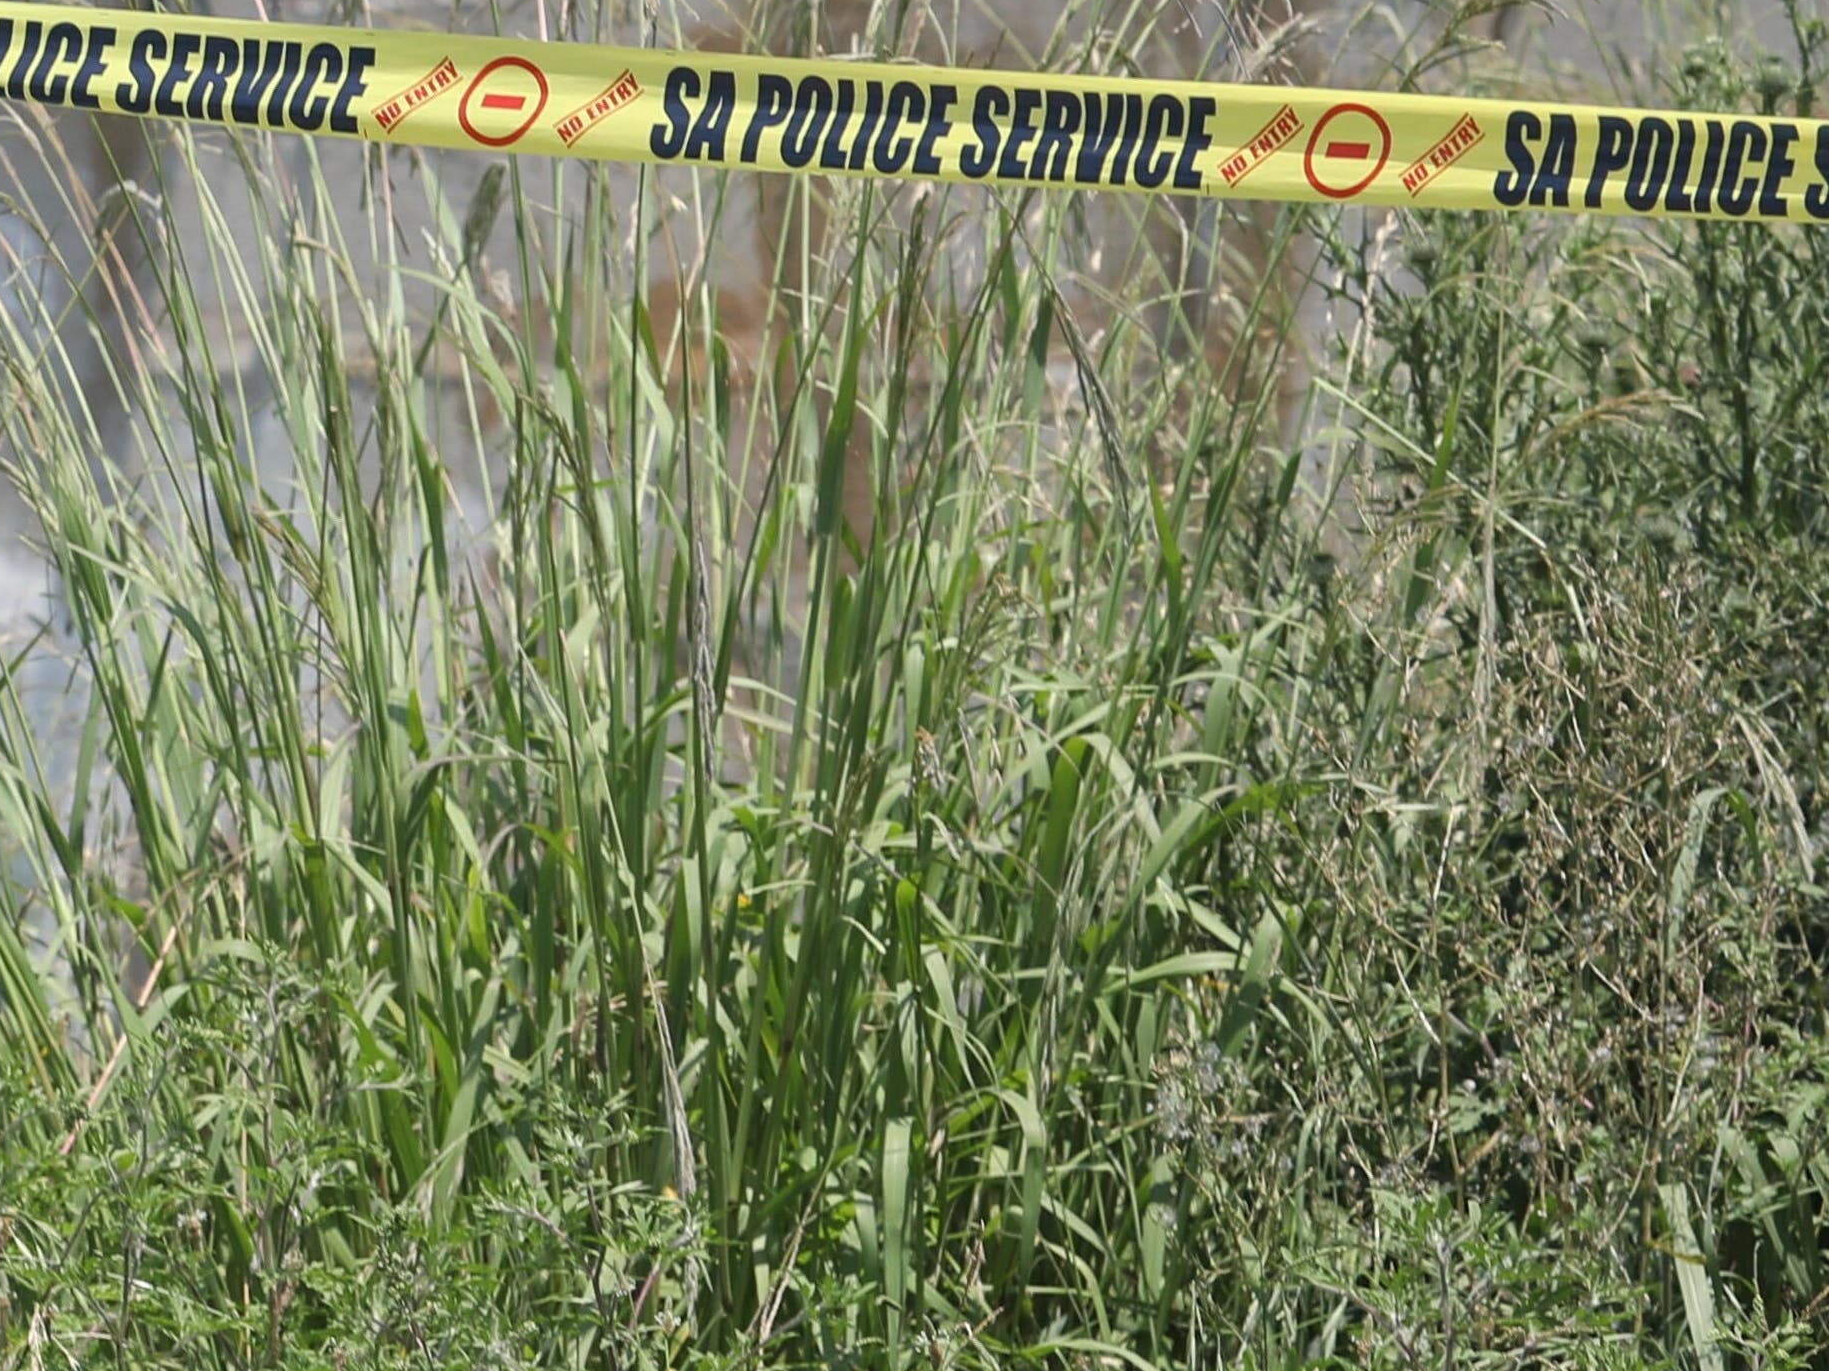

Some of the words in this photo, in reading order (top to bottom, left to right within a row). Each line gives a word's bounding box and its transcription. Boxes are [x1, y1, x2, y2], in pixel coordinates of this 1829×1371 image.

[115, 28, 376, 133] SERVICE
[375, 100, 401, 128] NO
[405, 59, 459, 107] ENTRY
[557, 116, 583, 143] NO
[587, 73, 640, 119] ENTRY
[649, 67, 736, 162] SA
[740, 73, 958, 179] POLICE
[959, 85, 1217, 190] SERVICE
[1221, 156, 1248, 183] NO
[1249, 107, 1300, 160] ENTRY
[1401, 165, 1429, 192] NO
[1429, 116, 1482, 168] ENTRY
[1493, 110, 1579, 207] SA
[1584, 113, 1799, 218] POLICE
